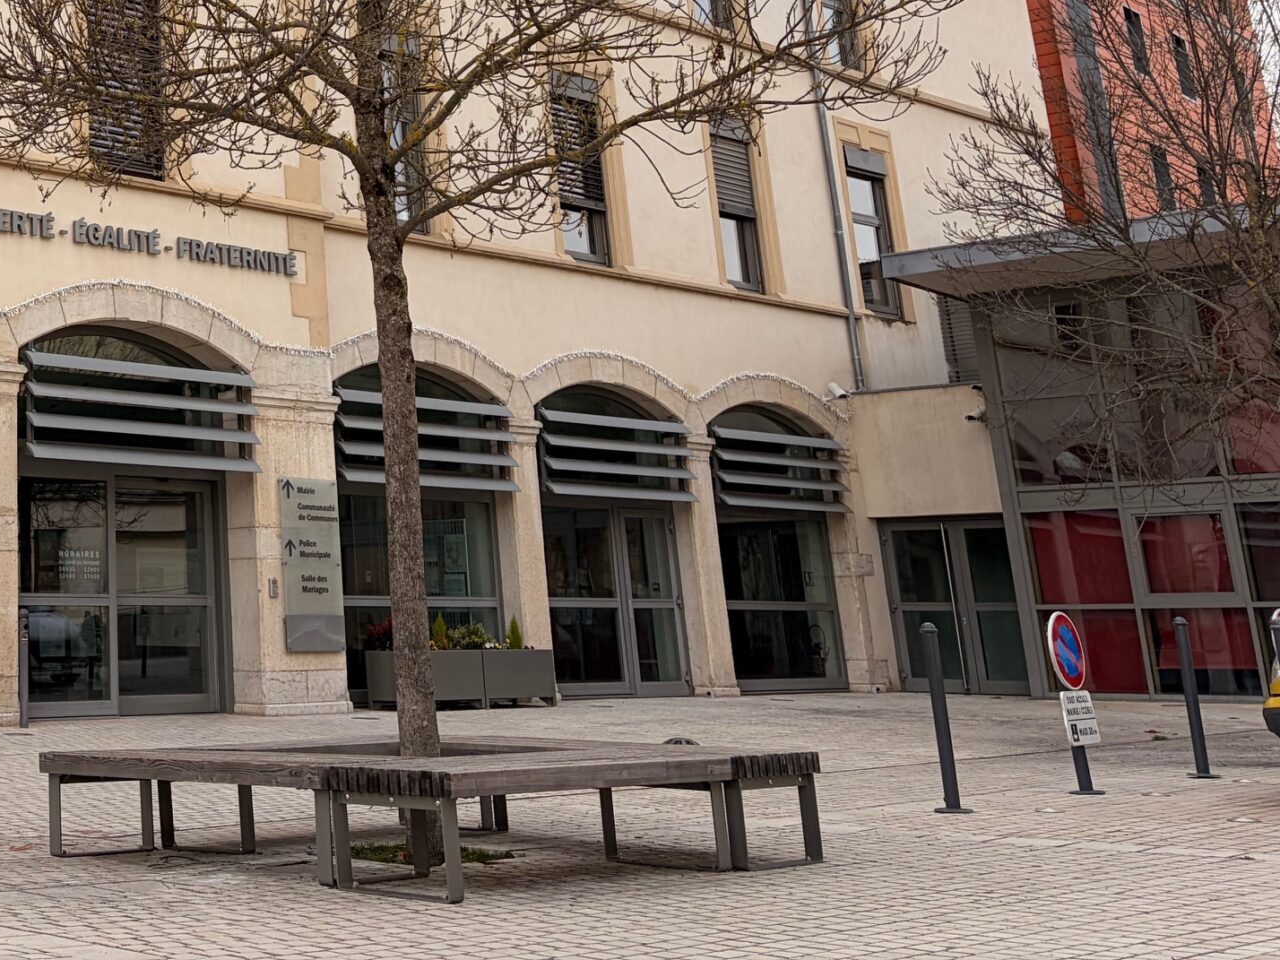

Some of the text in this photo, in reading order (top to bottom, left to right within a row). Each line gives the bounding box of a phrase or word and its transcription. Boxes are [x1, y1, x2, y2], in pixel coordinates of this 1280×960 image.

[72, 216, 161, 255] ÉGALITÉ
[177, 236, 297, 276] FRATERNITÉ
[296, 486, 316, 495] Mairie
[297, 502, 335, 512] Communauté
[306, 514, 338, 522] Communes
[299, 539, 317, 547] Police
[58, 550, 100, 558] HORAIRES
[299, 550, 331, 560] Municipale
[301, 574, 328, 582] Salle des
[301, 585, 329, 595] Mariages
